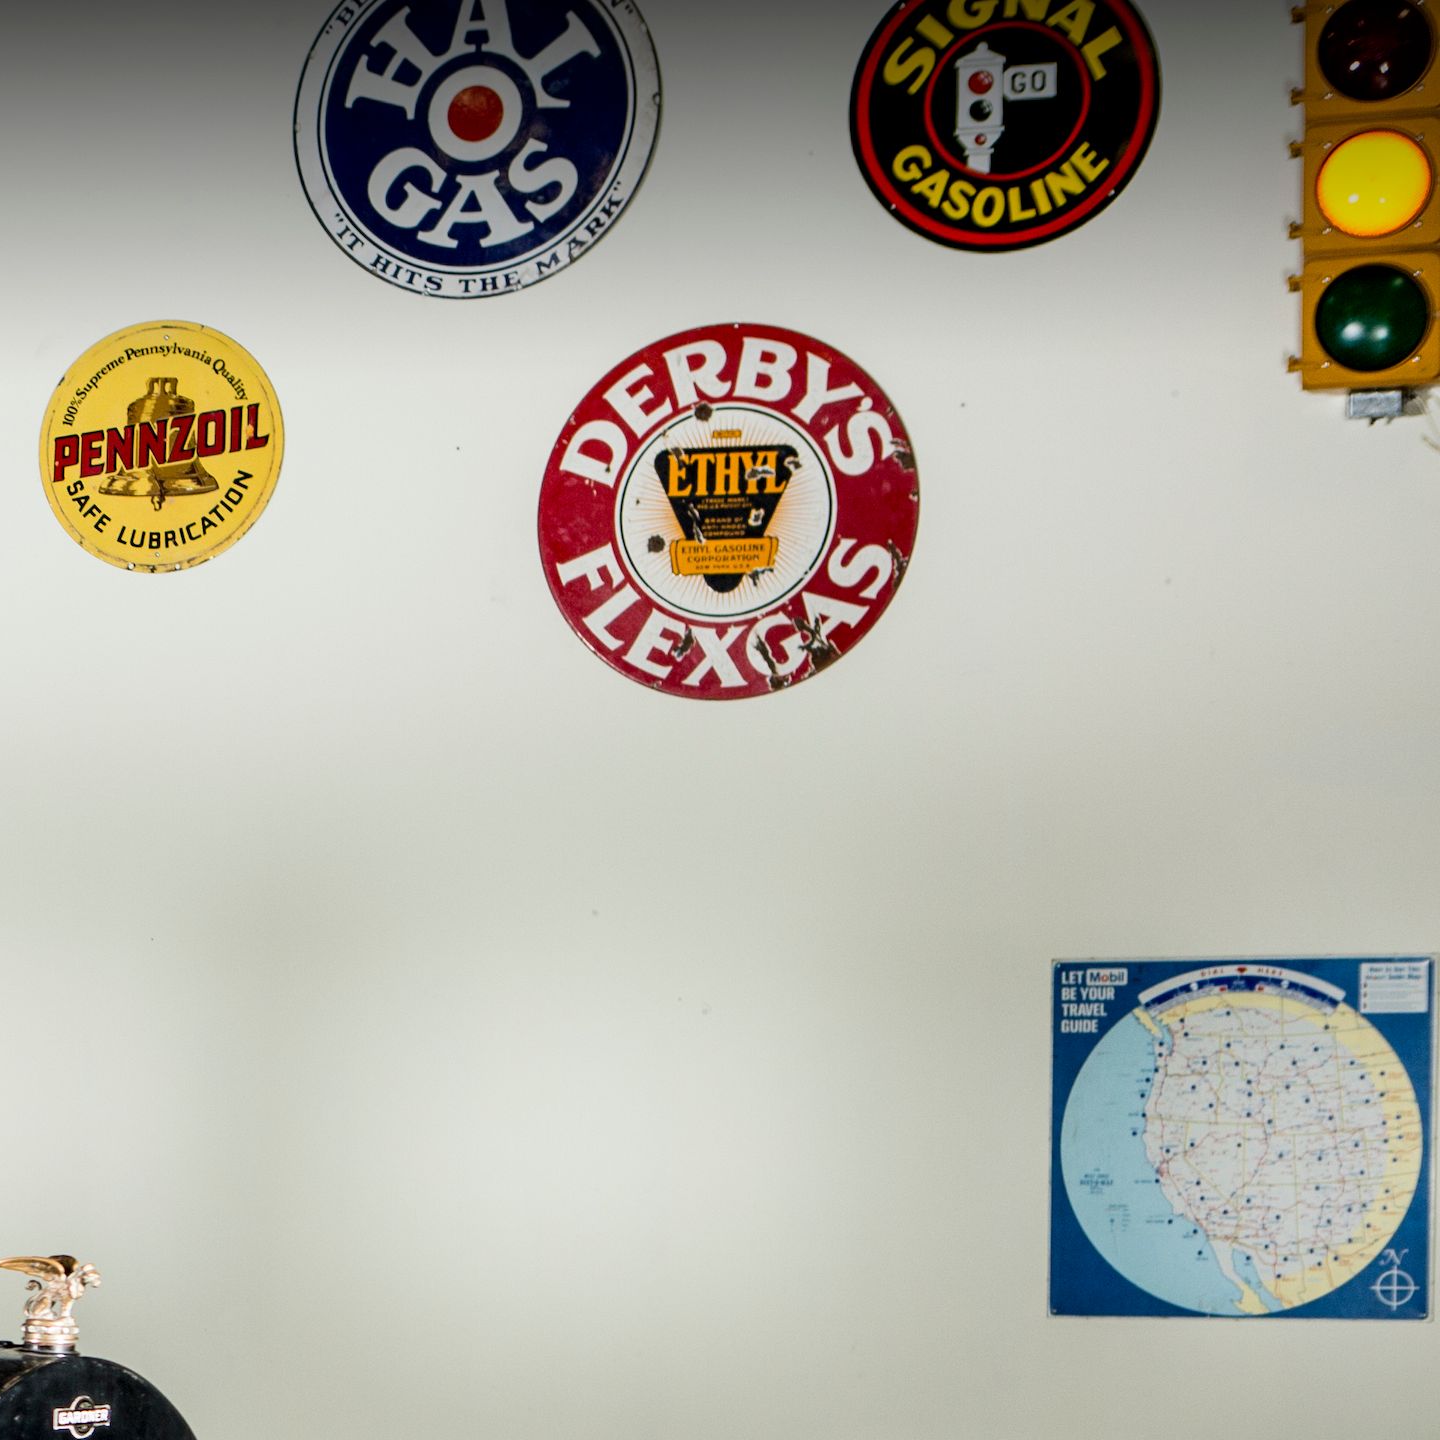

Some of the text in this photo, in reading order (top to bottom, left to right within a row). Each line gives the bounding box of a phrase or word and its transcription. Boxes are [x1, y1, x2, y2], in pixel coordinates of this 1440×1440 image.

[1011, 70, 1047, 94] GO
[367, 137, 578, 249] GAS
[891, 141, 1110, 228] GASOLINE
[369, 253, 444, 291] HITS
[458, 271, 522, 294] THE
[62, 342, 248, 427] 100% Supreme Pennsylvania Quality
[558, 336, 897, 488] DERBY'S
[52, 402, 270, 483] PENNZOIL
[666, 450, 788, 498] ETHYL
[66, 469, 254, 549] SAFE LUBRICATION
[681, 543, 765, 554] ETHYL GASOLINE
[687, 553, 760, 563] CORPORATION
[555, 534, 893, 690] FLEXGAS
[1061, 970, 1125, 985] LET Mobil
[1061, 986, 1116, 1001] BE YOUR
[1061, 1002, 1108, 1017] TRAVEL
[1061, 1019, 1099, 1033] GUIDE
[1378, 1247, 1410, 1266] N
